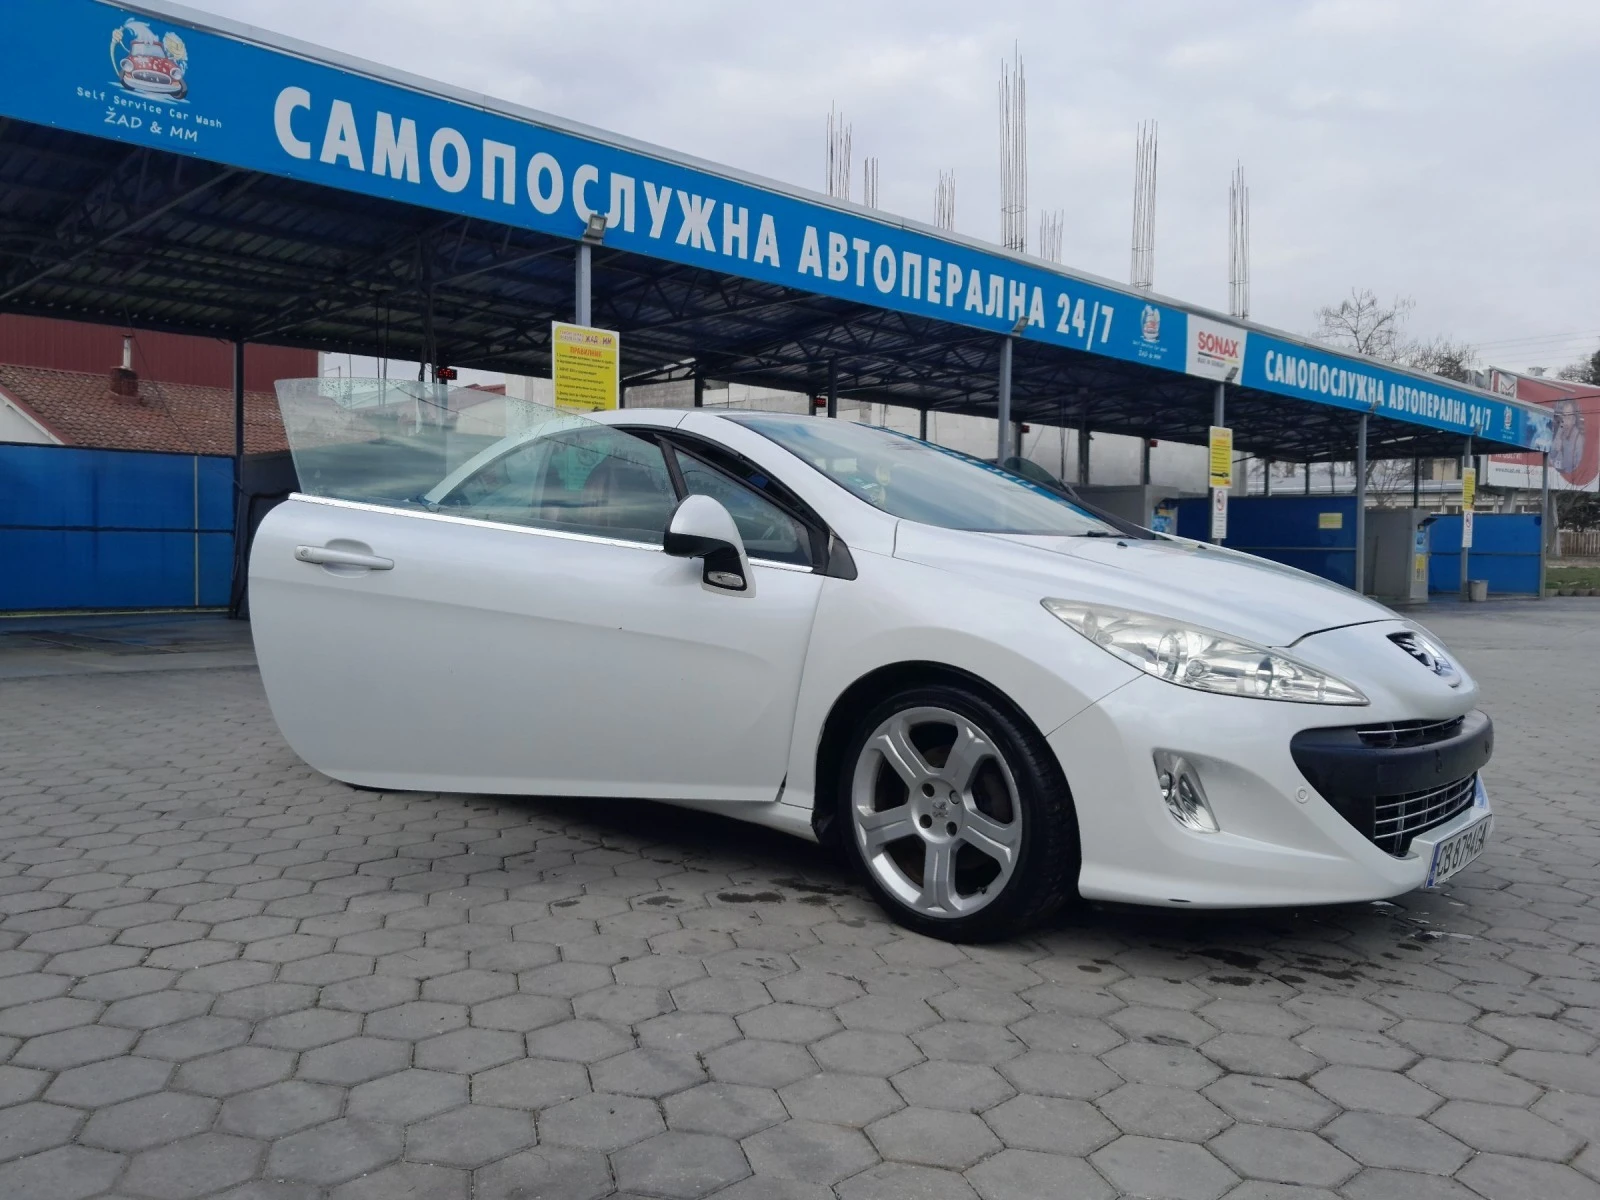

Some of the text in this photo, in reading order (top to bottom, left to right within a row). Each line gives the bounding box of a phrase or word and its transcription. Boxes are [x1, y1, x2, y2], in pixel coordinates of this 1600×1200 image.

[76, 86, 222, 129] Self Service Car Wash
[104, 106, 198, 143] ŽAD & MM
[274, 86, 1114, 351] САМОПОСЛУЖНА АВТОПЕРАЛНА 24/7
[1198, 331, 1239, 358] SONAX
[1265, 350, 1492, 436] САМОПОСЛУЖНА АВТОПЕРАЛНА 24/7
